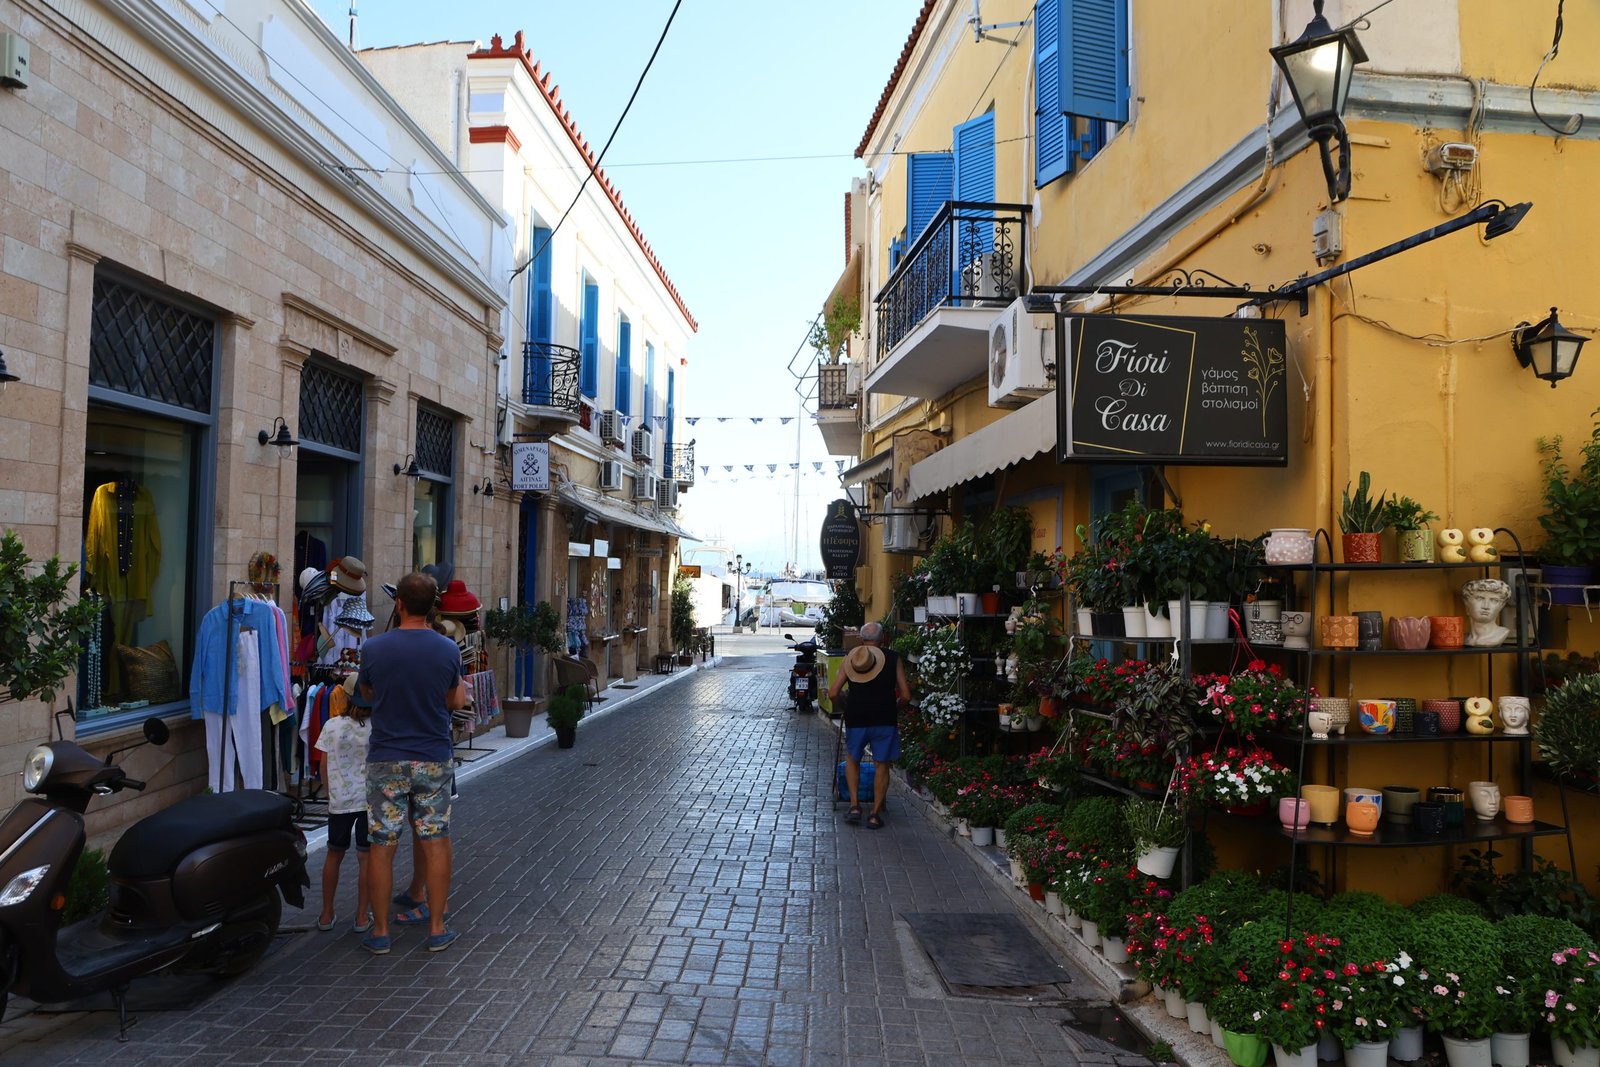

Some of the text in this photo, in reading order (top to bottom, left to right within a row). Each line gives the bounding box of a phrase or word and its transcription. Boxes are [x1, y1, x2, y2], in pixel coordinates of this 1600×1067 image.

[1095, 339, 1171, 374] Fiori
[1201, 367, 1239, 381] γάμος
[1119, 378, 1147, 397] Di
[1201, 382, 1249, 397] βάπτιση
[1201, 397, 1259, 412] στολισμοί
[1094, 396, 1172, 432] Casa
[1205, 440, 1281, 451] www.fioridicasa.gr
